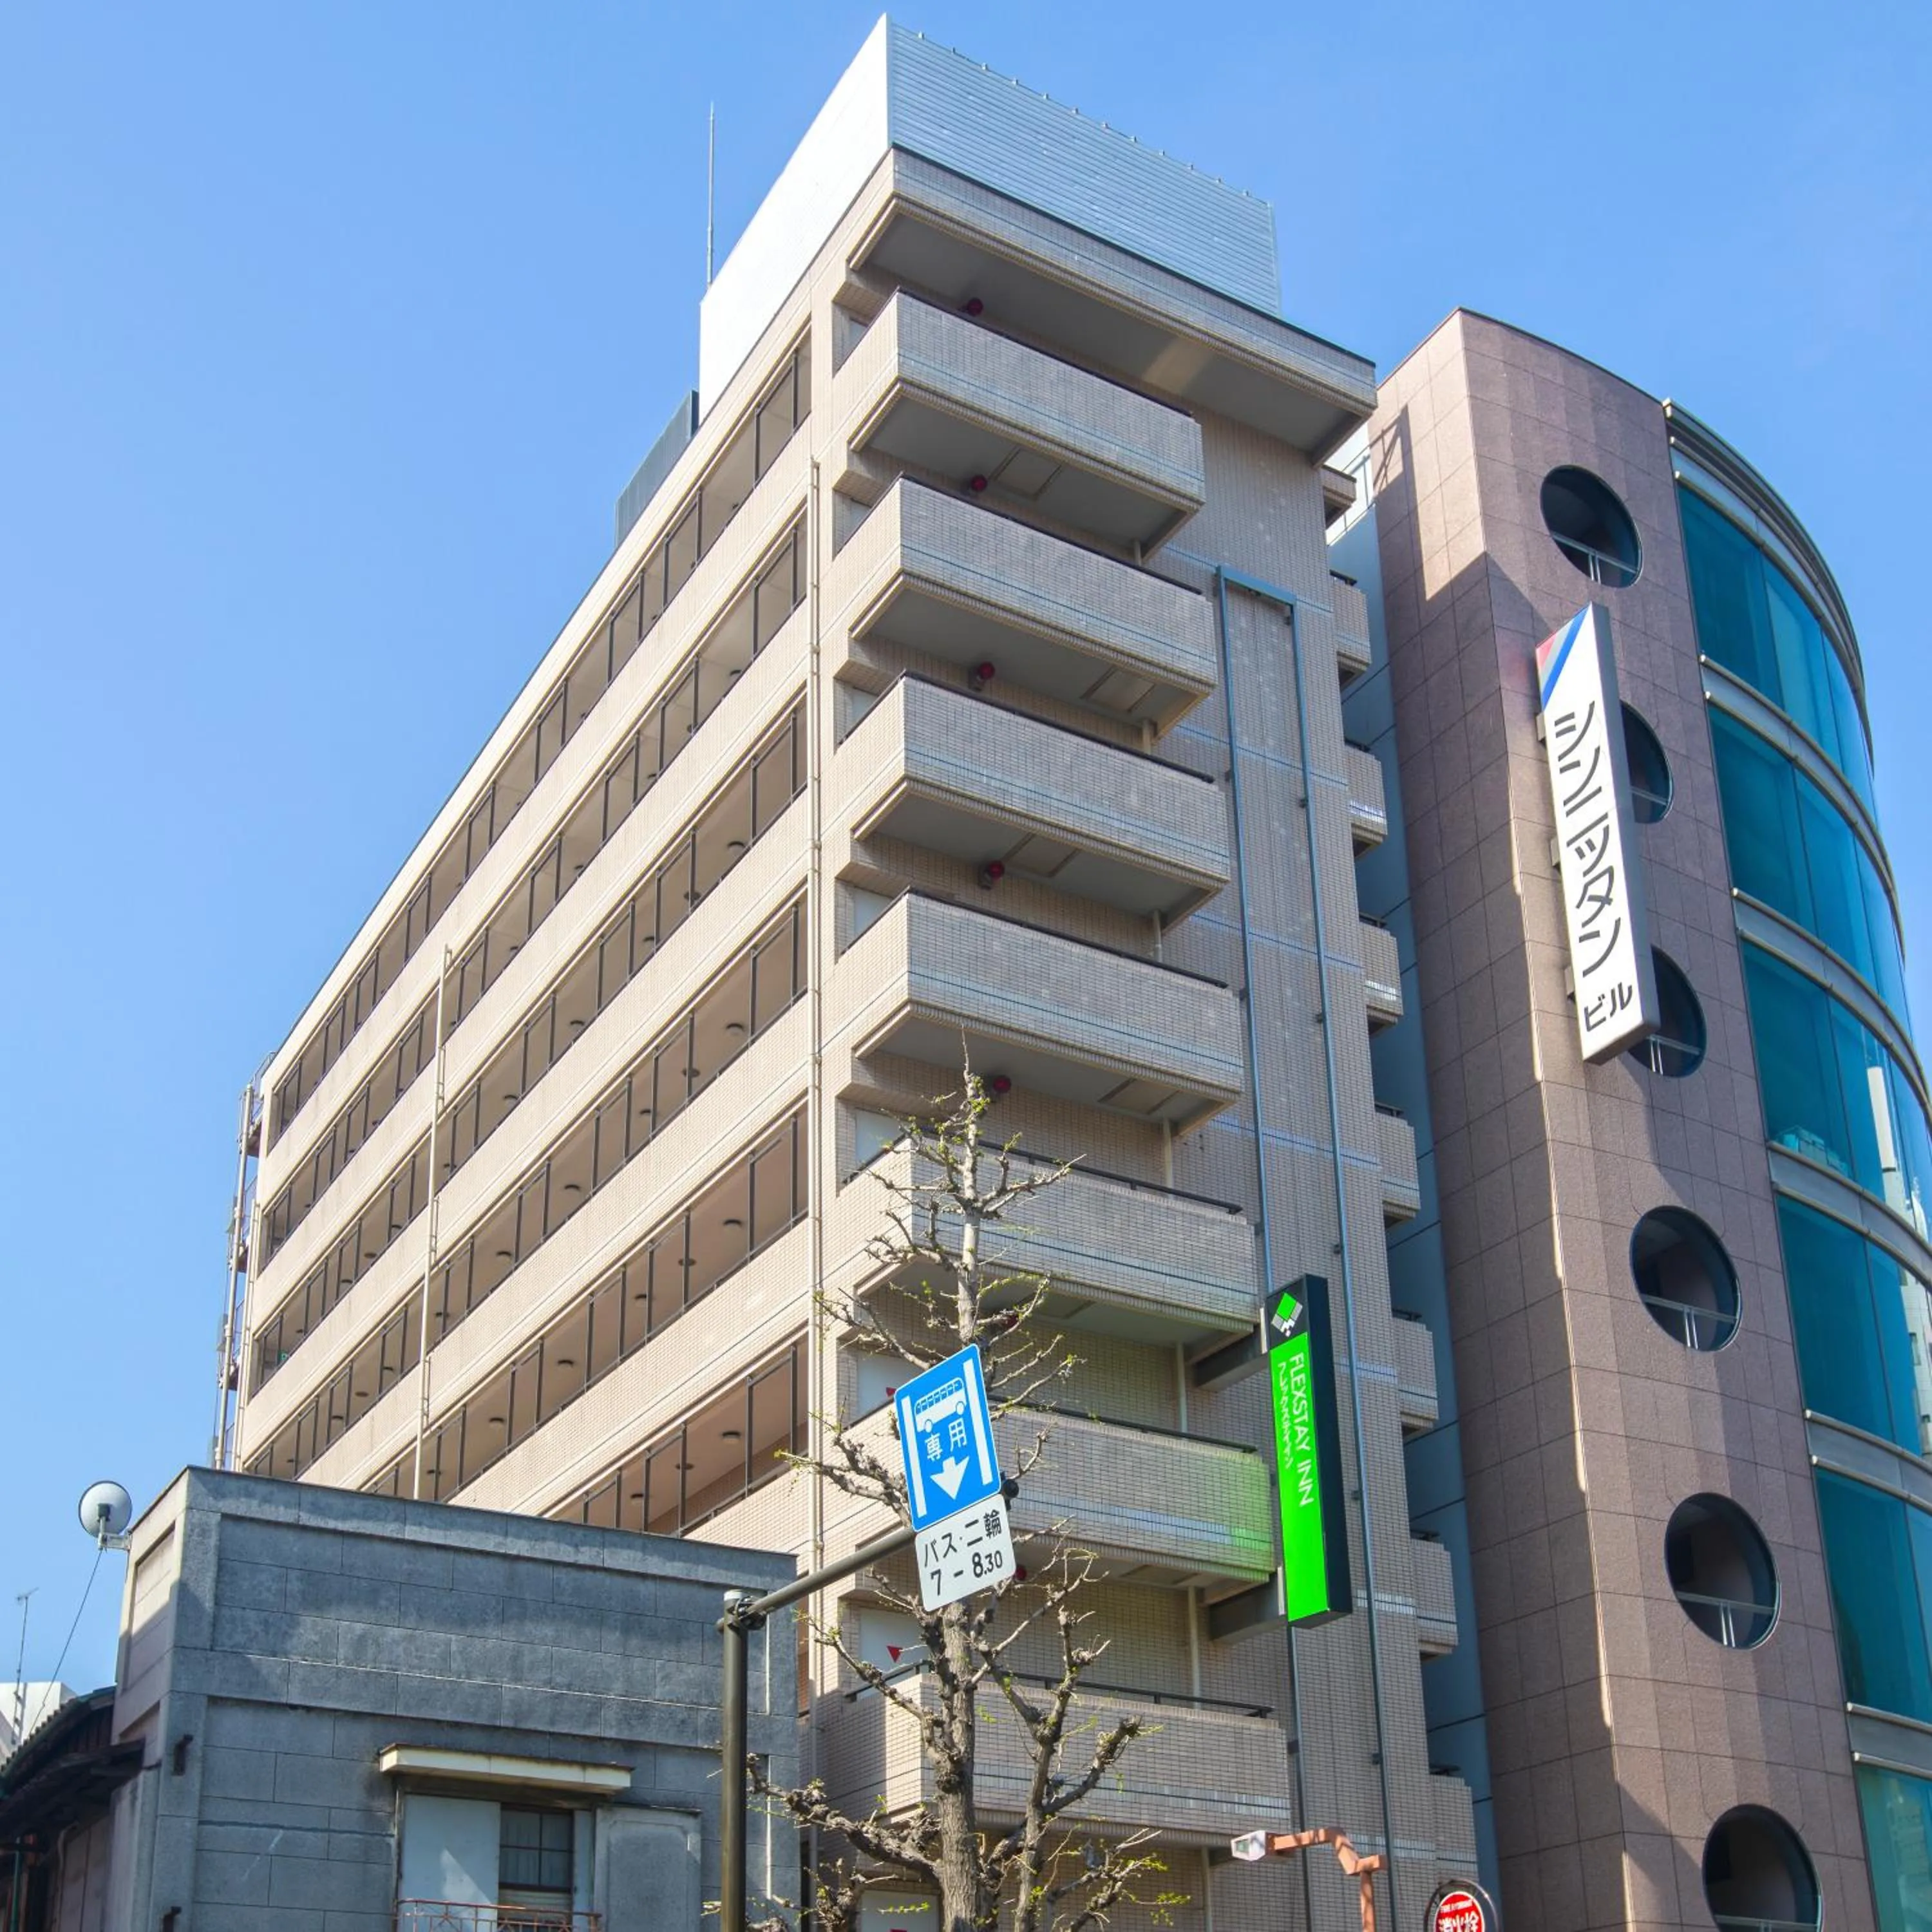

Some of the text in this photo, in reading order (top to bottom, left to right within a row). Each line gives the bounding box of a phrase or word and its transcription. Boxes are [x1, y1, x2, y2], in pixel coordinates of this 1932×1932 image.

[1554, 700, 1621, 977] シンニッタン
[1584, 982, 1633, 1032] ビル
[924, 1417, 967, 1461] 専用
[1289, 1352, 1314, 1507] FLEXSTAY INN
